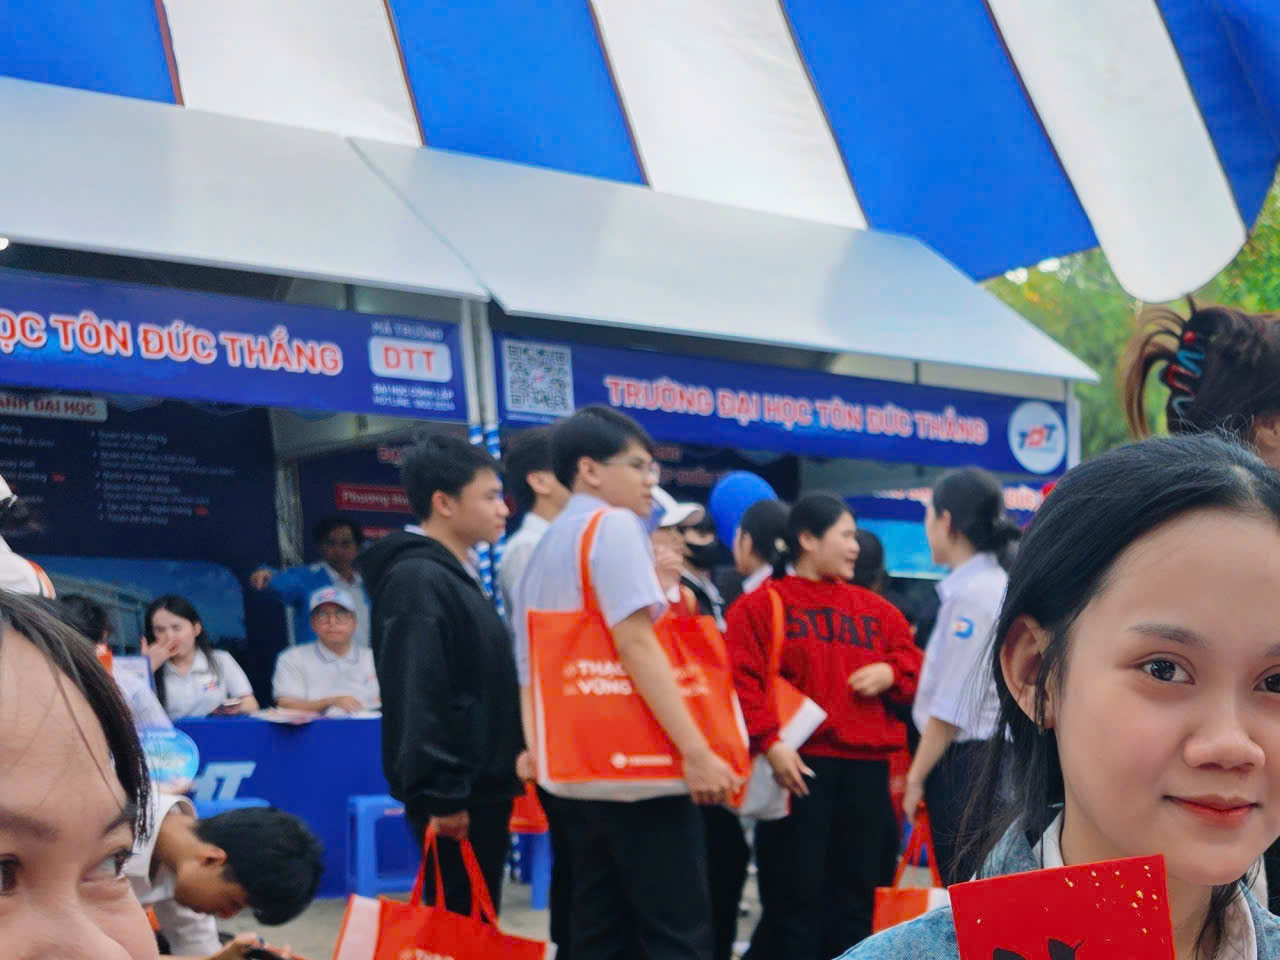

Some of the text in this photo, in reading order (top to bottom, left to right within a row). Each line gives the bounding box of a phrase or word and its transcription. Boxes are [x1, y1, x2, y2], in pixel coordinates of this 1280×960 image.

[50, 310, 132, 357] TÔN
[138, 319, 217, 364] ĐỨC
[219, 324, 343, 376] THẮNG
[384, 346, 436, 374] DTT
[603, 375, 989, 446] TRƯỜNG ĐẠI HỌC TÔN ĐỨC THẮNG
